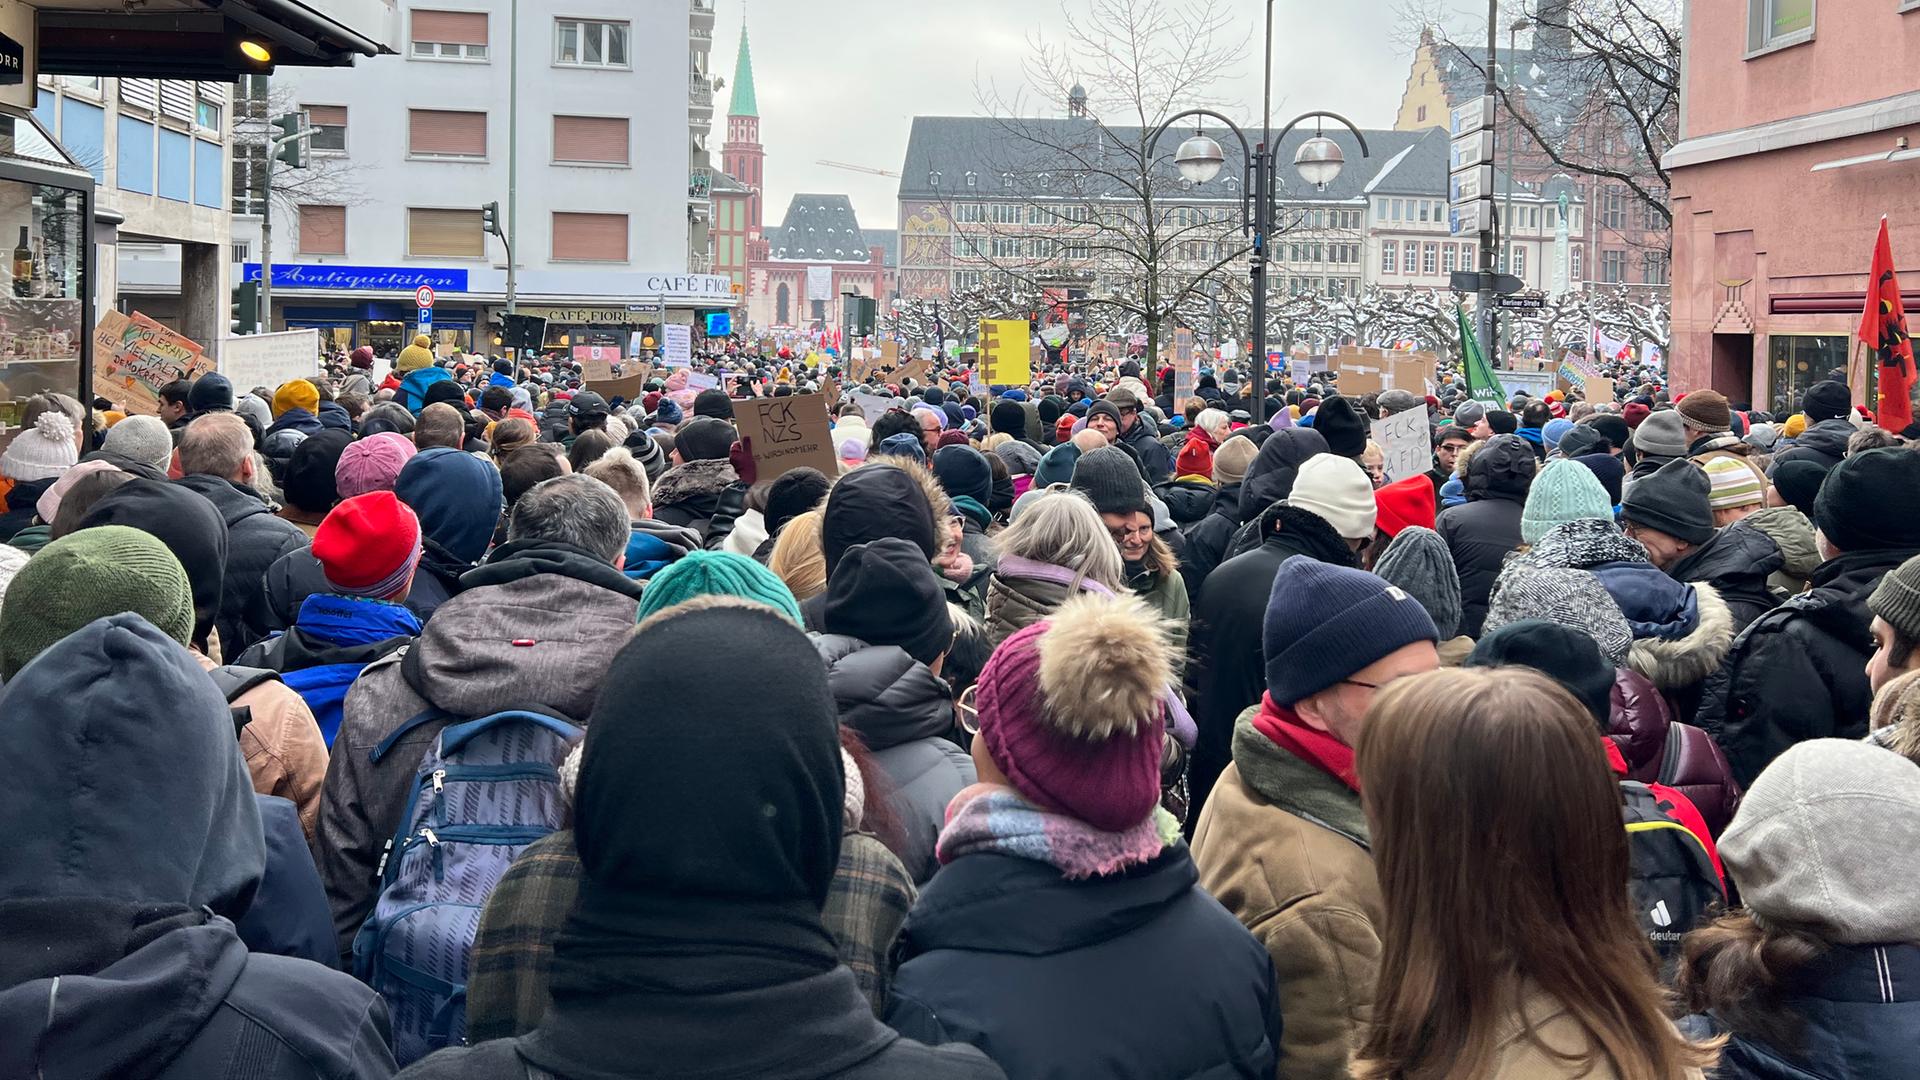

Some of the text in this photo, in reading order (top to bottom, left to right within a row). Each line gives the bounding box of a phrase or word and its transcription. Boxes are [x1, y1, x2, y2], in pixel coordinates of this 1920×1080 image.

[252, 268, 455, 287] Antiquitäten
[648, 275, 698, 291] CAFÉ
[420, 291, 431, 302] 40
[1523, 299, 1540, 307] Straße
[421, 309, 429, 322] P
[549, 310, 632, 321] CAFÉ FIORE
[137, 323, 192, 366] TOLERANZ
[124, 341, 182, 378] VIELFALT
[113, 355, 166, 389] DEMOKRATI
[758, 401, 796, 425] FCK
[762, 423, 802, 443] NZS
[1384, 417, 1416, 442] FCK
[1386, 446, 1422, 474] AFD
[1650, 930, 1681, 941] deuter
